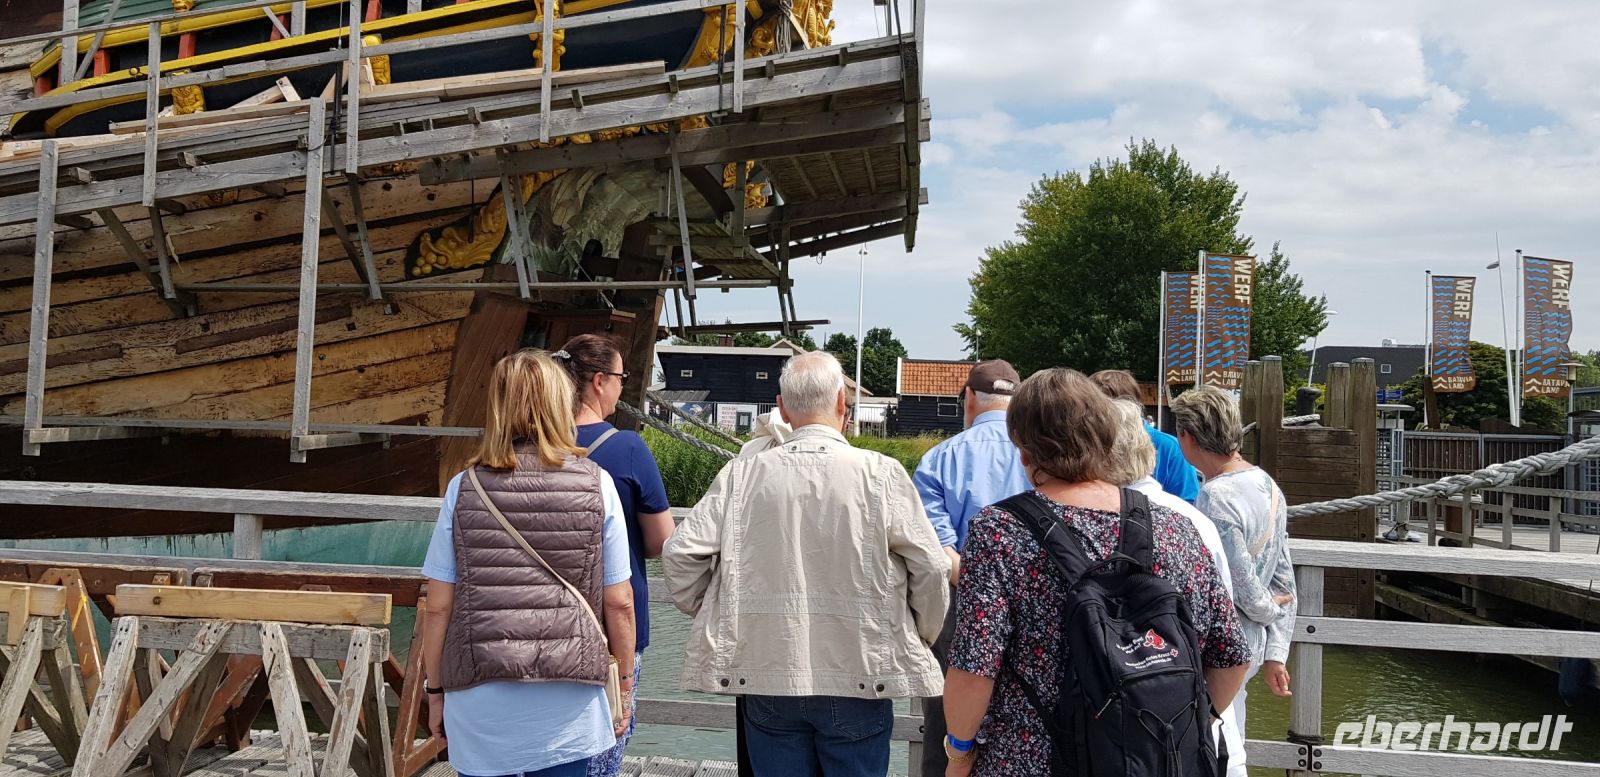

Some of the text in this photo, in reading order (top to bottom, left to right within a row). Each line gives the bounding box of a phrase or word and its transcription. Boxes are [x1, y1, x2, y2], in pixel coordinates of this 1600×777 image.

[1234, 259, 1252, 305] WERF
[1453, 279, 1473, 319] WERF
[1552, 264, 1570, 311] WERF
